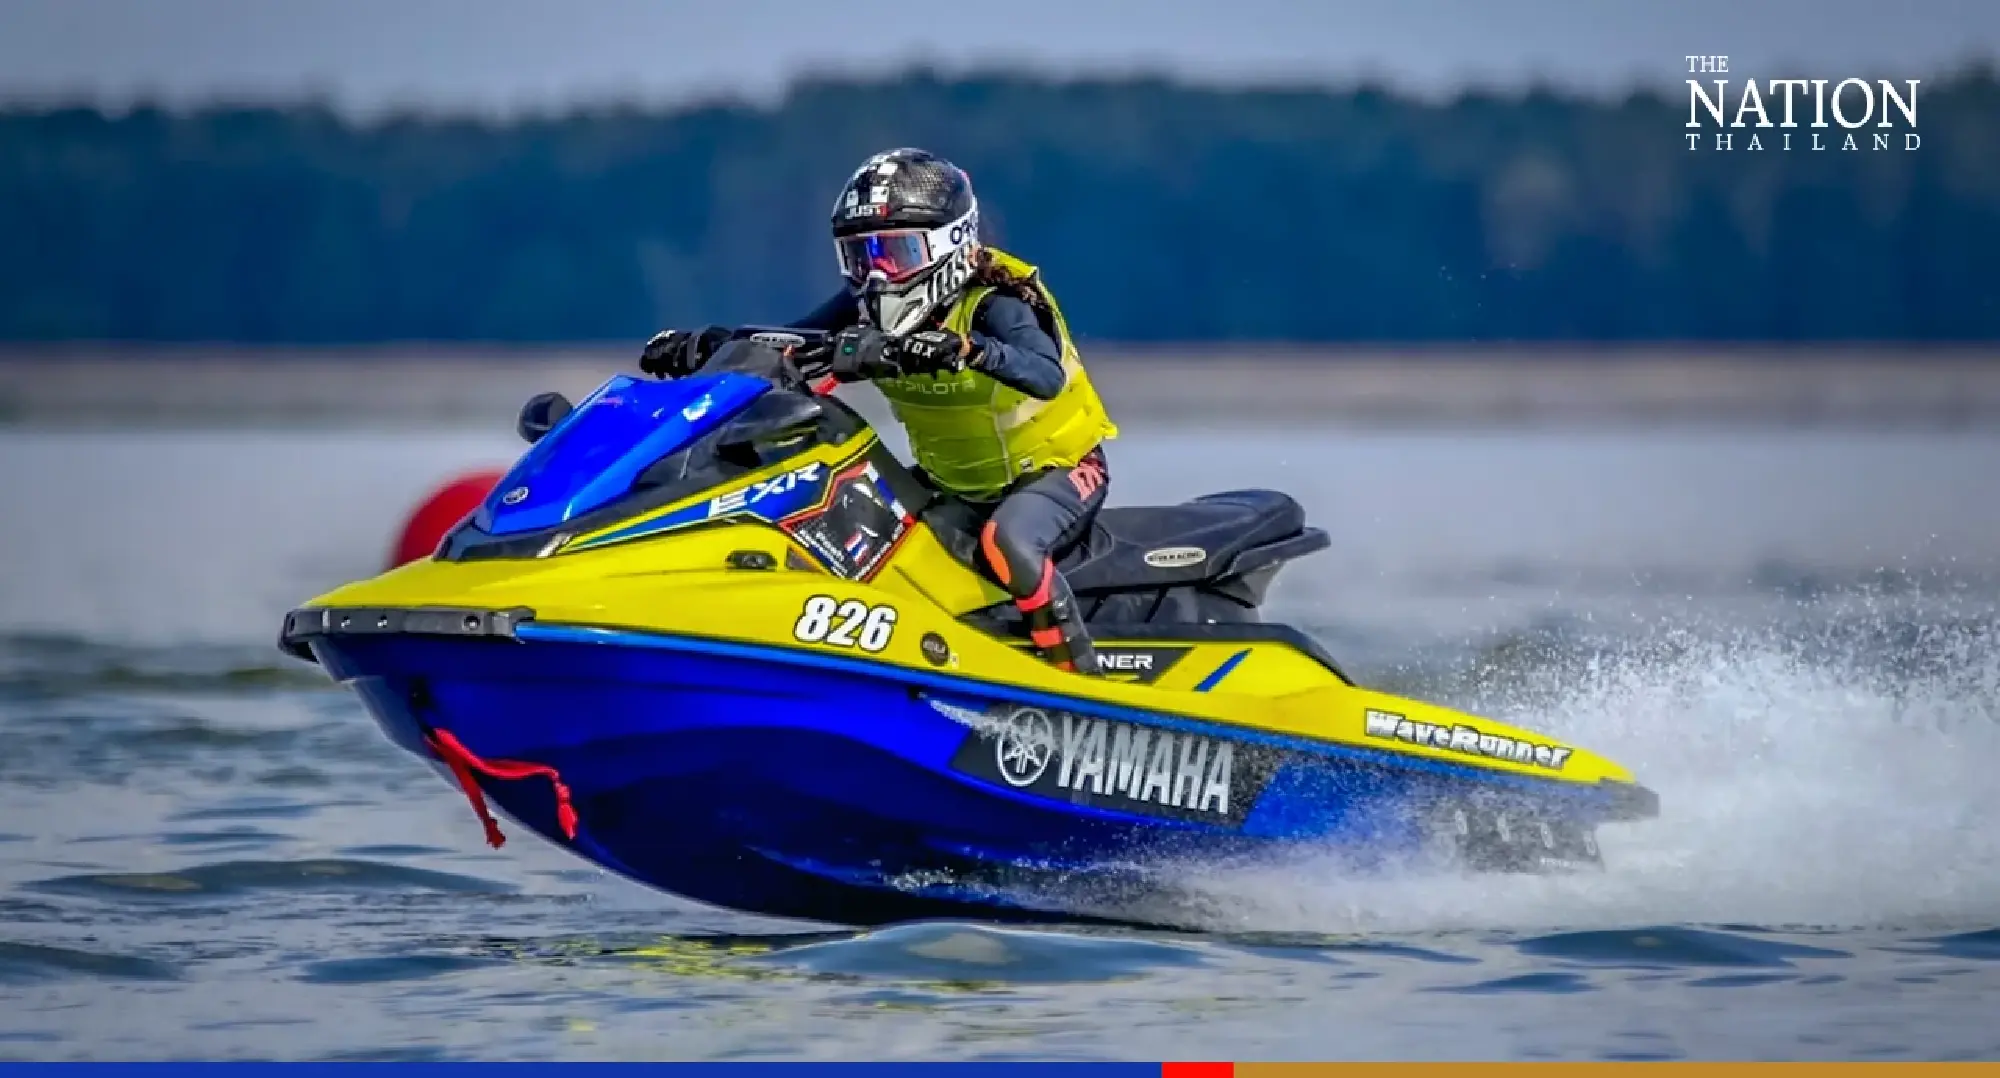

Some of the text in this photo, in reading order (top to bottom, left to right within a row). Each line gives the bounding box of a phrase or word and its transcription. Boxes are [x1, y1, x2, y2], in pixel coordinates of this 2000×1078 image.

[903, 338, 936, 358] FOX
[708, 461, 820, 517] EXR
[793, 594, 898, 653] 826
[1057, 714, 1233, 815] YAMAHA
[1365, 708, 1574, 771] WaveRunner
